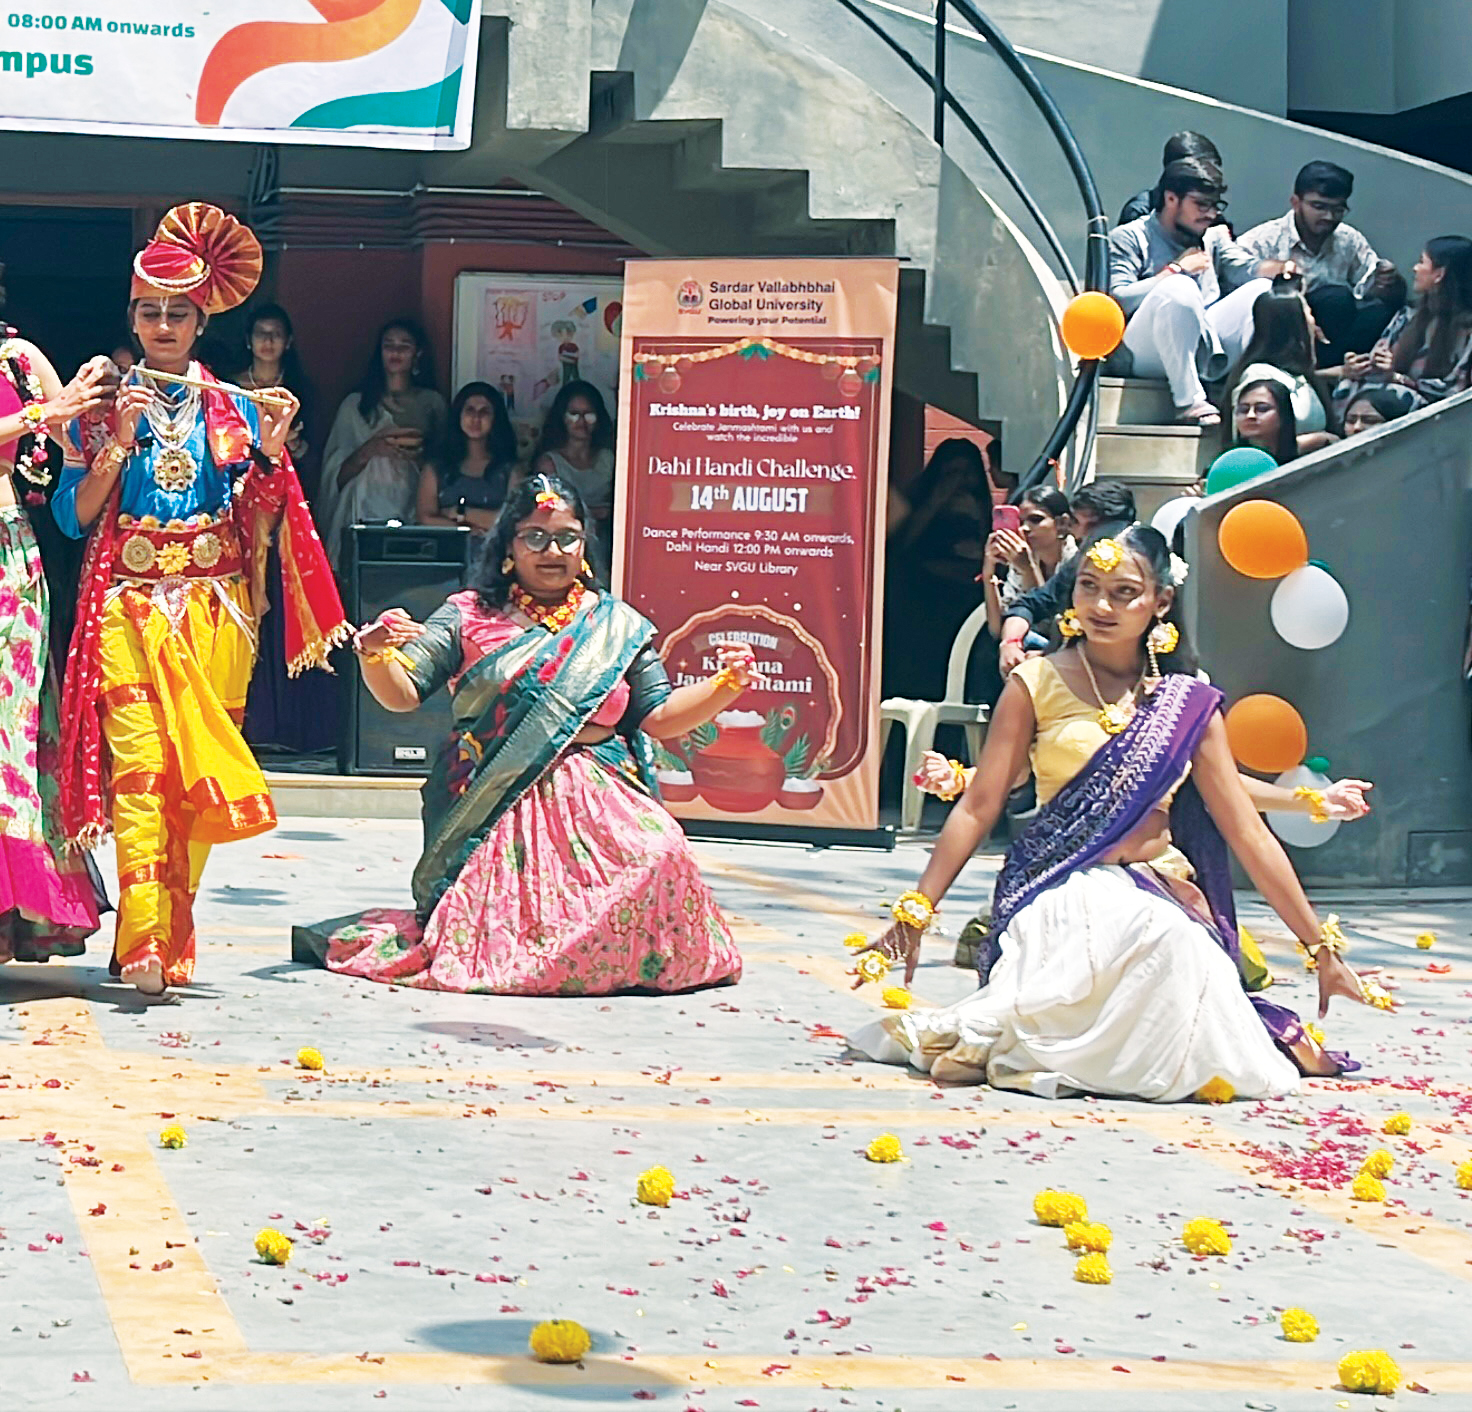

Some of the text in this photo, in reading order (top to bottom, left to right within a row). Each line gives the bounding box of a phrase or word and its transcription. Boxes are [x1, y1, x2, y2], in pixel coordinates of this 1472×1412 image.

[7, 13, 196, 38] 08:00 AM onwards
[710, 281, 835, 294] Sardar Vallabhbhai
[709, 298, 752, 311] Global
[756, 299, 823, 313] University
[708, 316, 827, 325] Powering your Potential
[649, 403, 861, 420] Krishna's birth, joy on Earth!
[673, 422, 715, 432] Celebrate
[717, 423, 777, 433] Janmashtami
[780, 423, 799, 433] with
[815, 424, 833, 434] and
[706, 433, 798, 443] watch the incredible
[648, 456, 857, 482] Dahi Handi Challenge.
[691, 485, 809, 513] 14th AUGUST
[642, 527, 854, 545] Dance Performance 9:30 AM onwards,
[666, 542, 834, 557] Dahi Handi 12:00 PM onwards
[694, 561, 798, 576] Near SVGU Library
[708, 631, 778, 650] CELEBRATION
[702, 656, 783, 674] Krna
